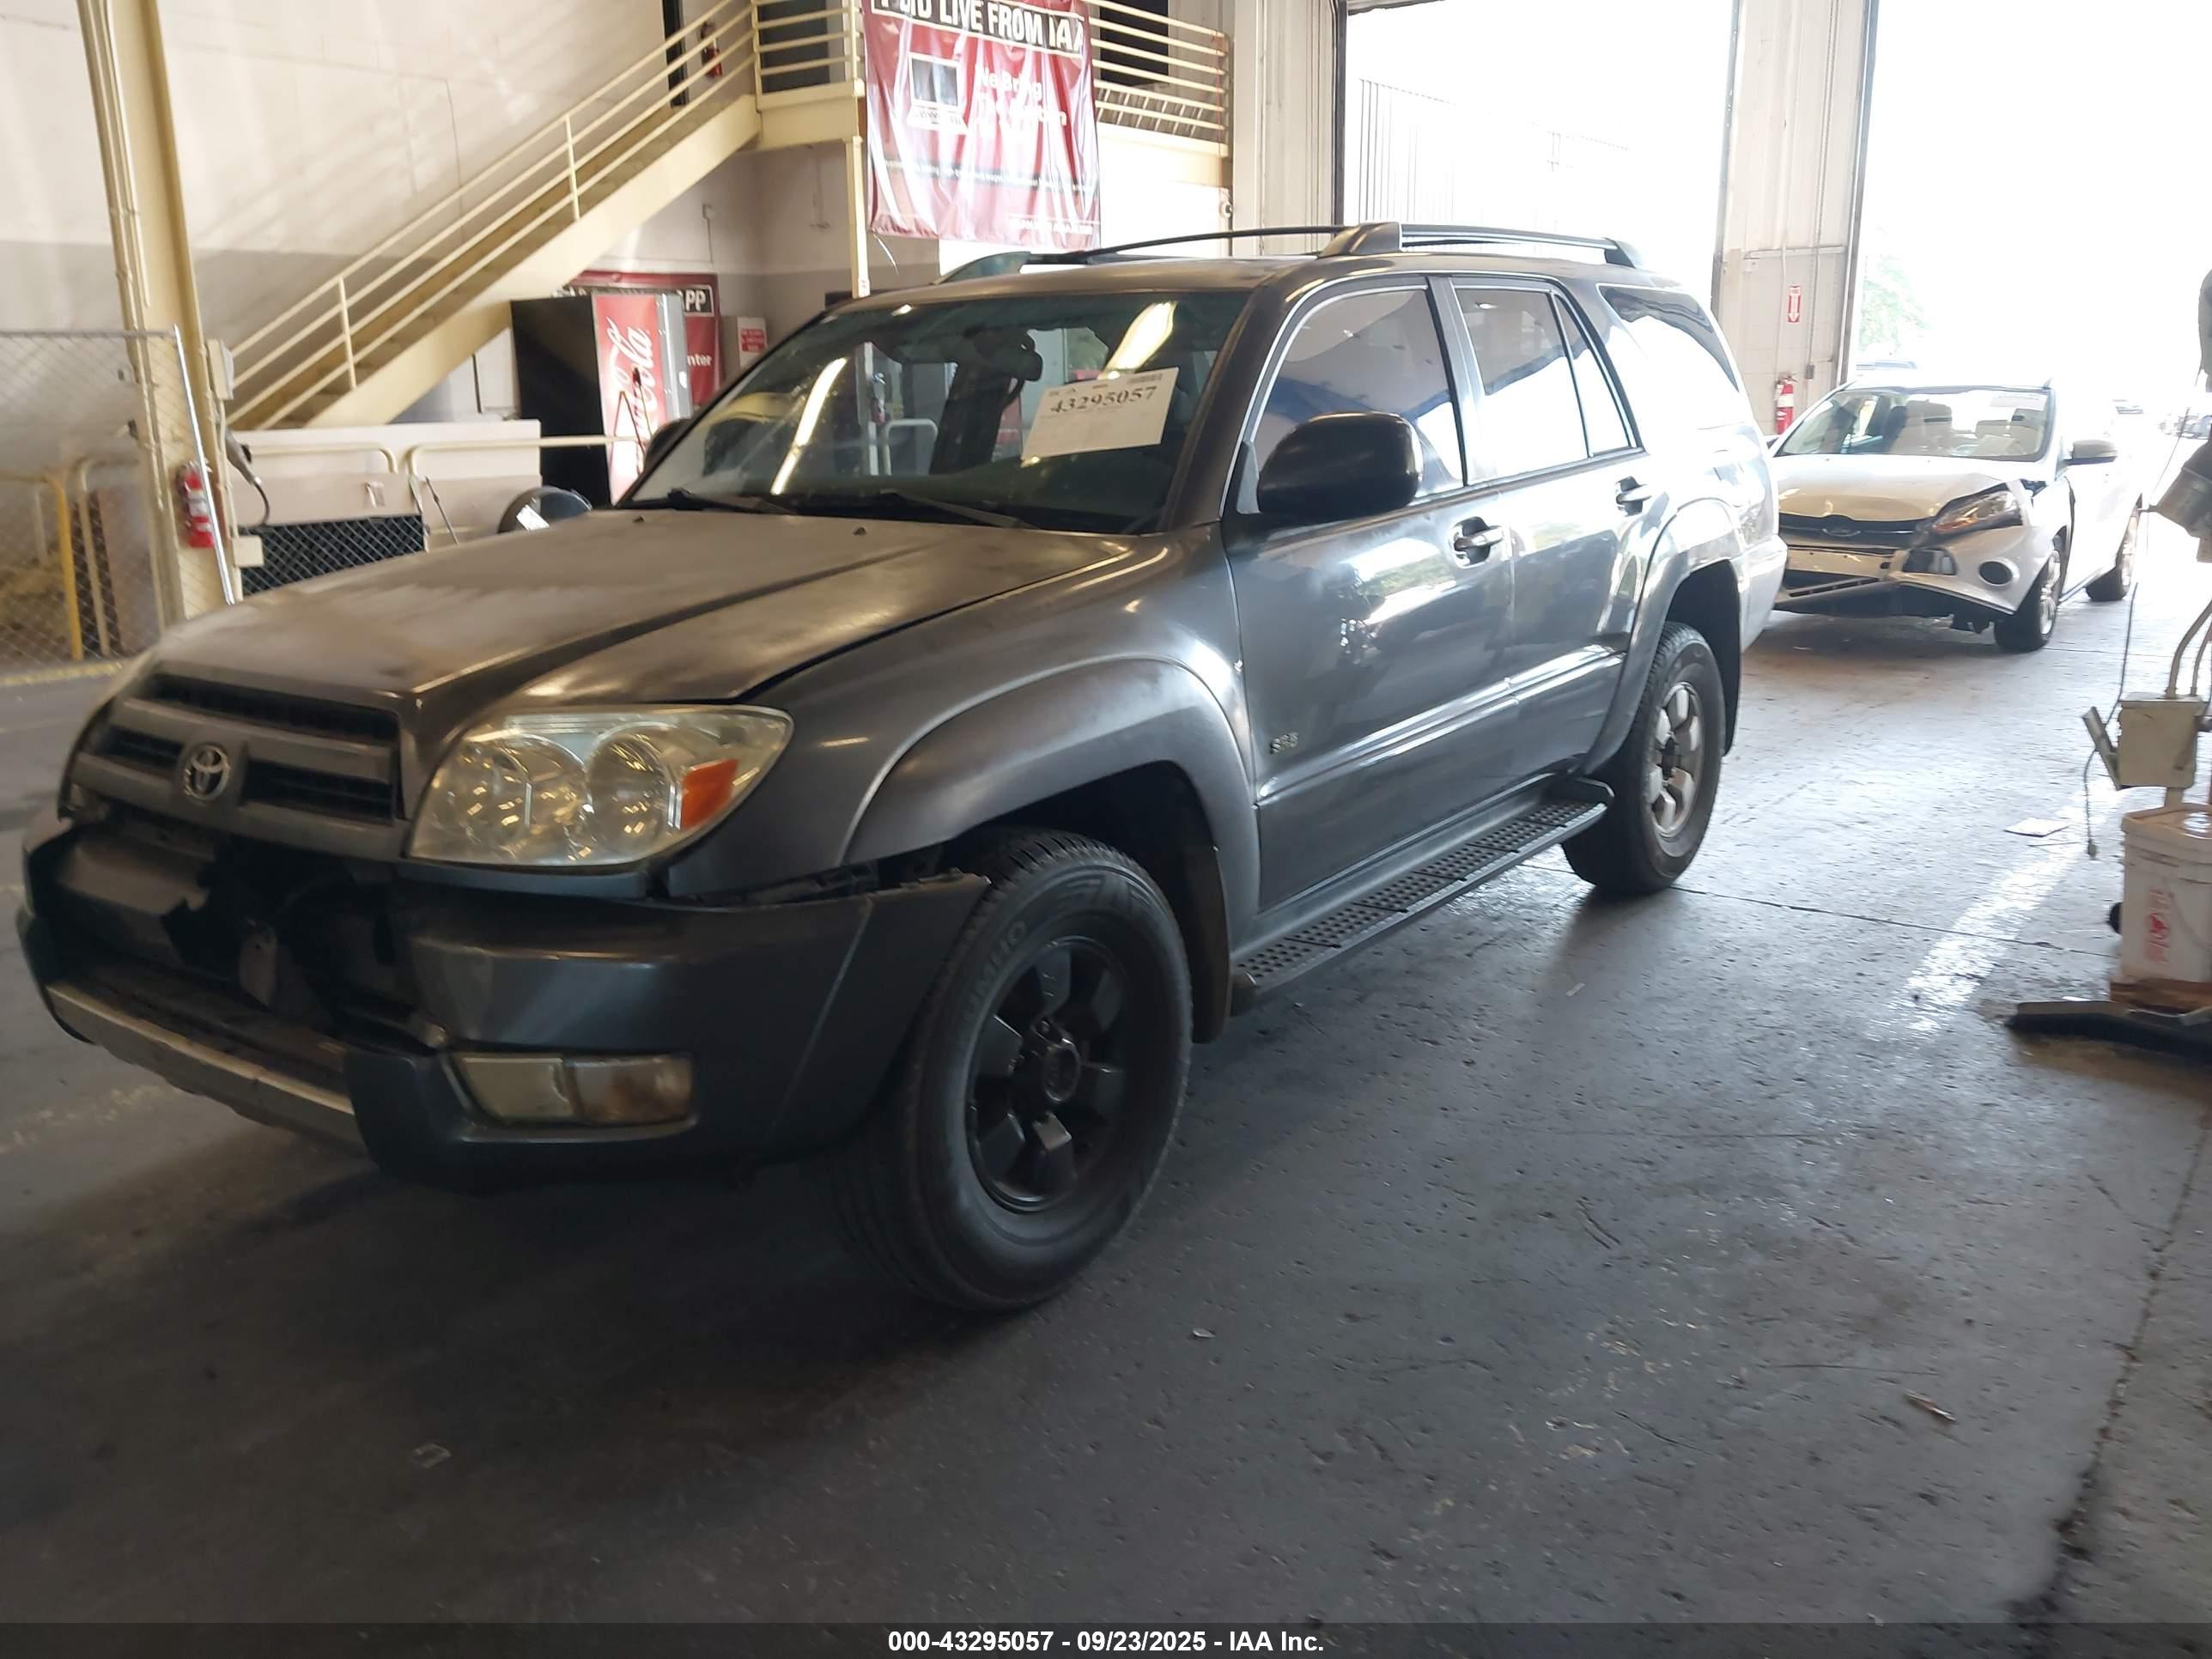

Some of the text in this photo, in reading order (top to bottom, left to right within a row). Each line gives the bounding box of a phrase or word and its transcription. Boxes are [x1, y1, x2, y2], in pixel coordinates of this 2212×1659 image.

[939, 0, 983, 32] LIVE
[988, 3, 1043, 45] FROM
[1048, 16, 1084, 52] IAA
[681, 289, 706, 311] PP
[687, 353, 712, 367] nter
[1050, 385, 1158, 413] 43295057
